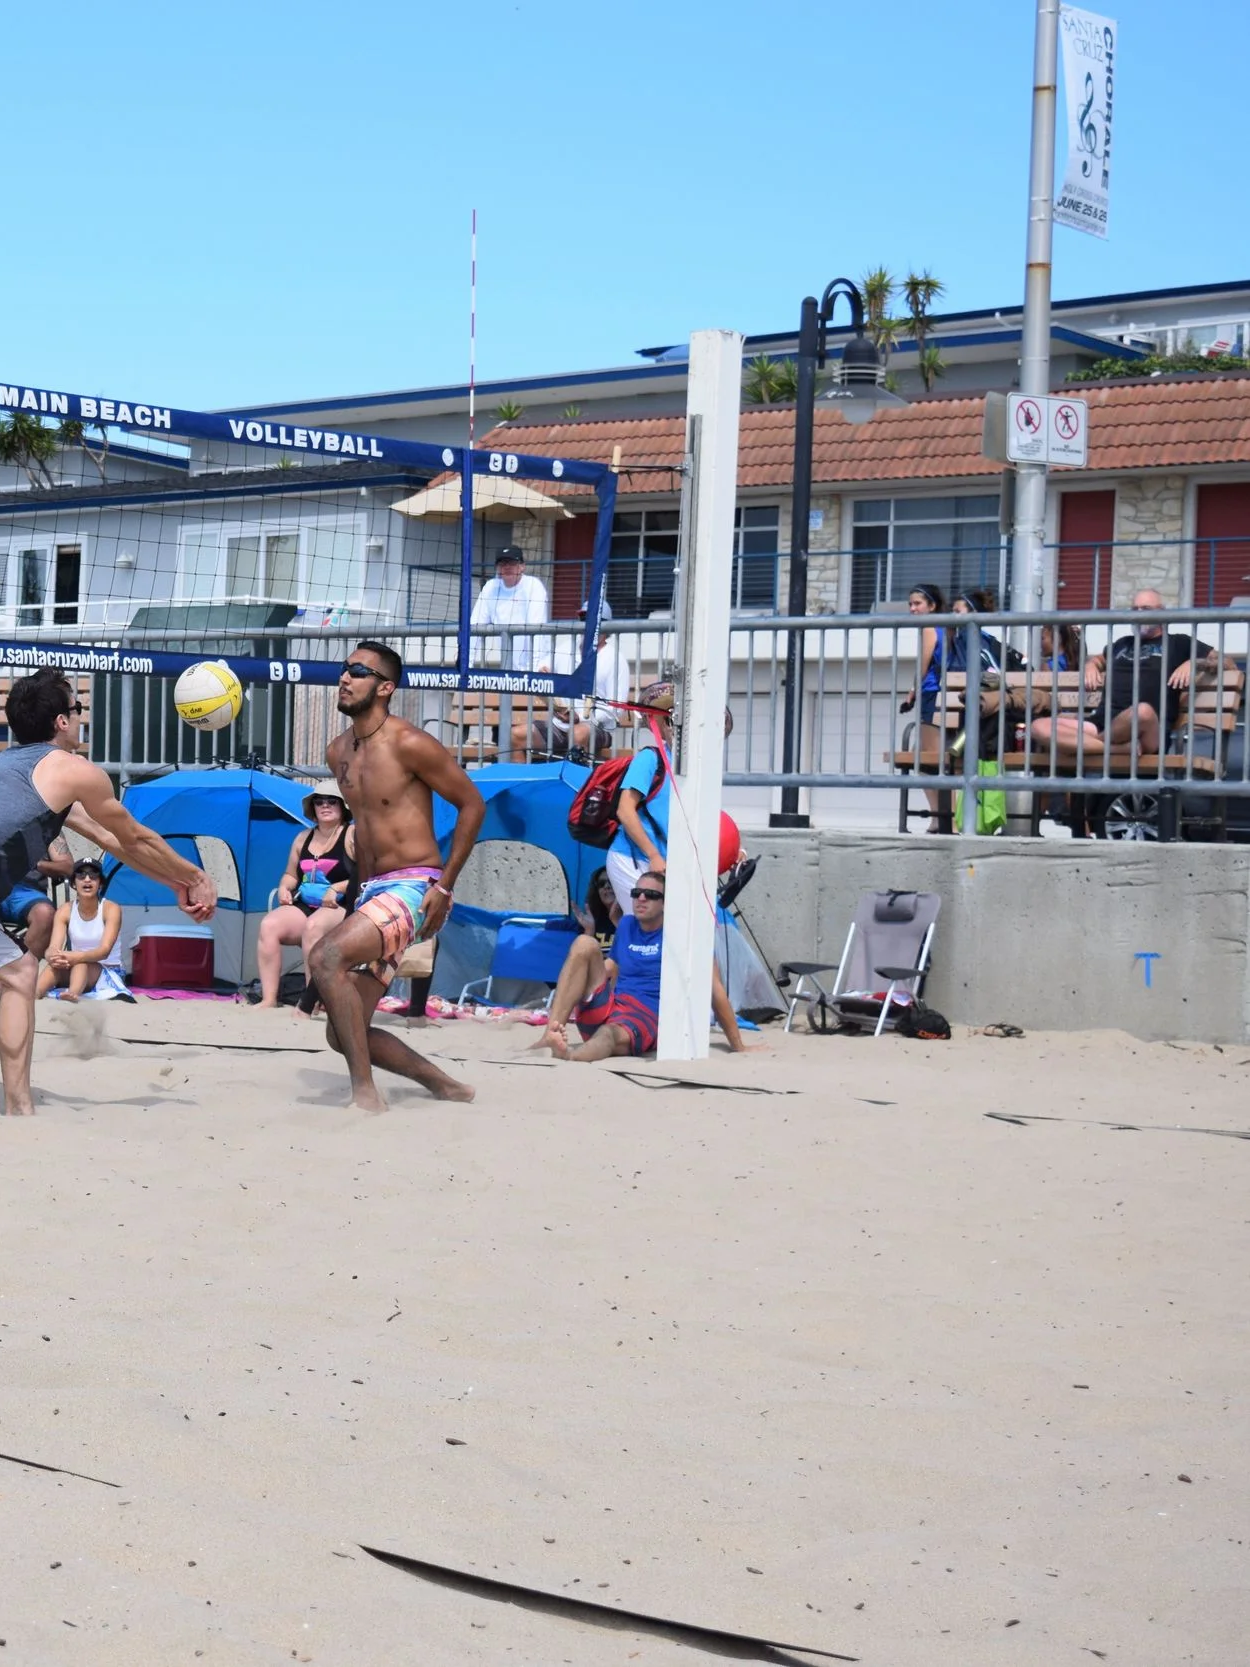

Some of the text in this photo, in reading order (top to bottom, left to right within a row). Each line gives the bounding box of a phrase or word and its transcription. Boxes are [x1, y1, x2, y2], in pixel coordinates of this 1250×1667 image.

[1062, 14, 1102, 43] SANTA
[1073, 38, 1103, 62] CRUZ
[1101, 26, 1113, 190] CHORALE
[1057, 196, 1082, 213] JUNE
[1081, 203, 1093, 217] 25
[80, 397, 171, 429] BEACH
[228, 419, 384, 458] VOLLEYBALL
[407, 672, 554, 694] www.sanacruzwharf.com
